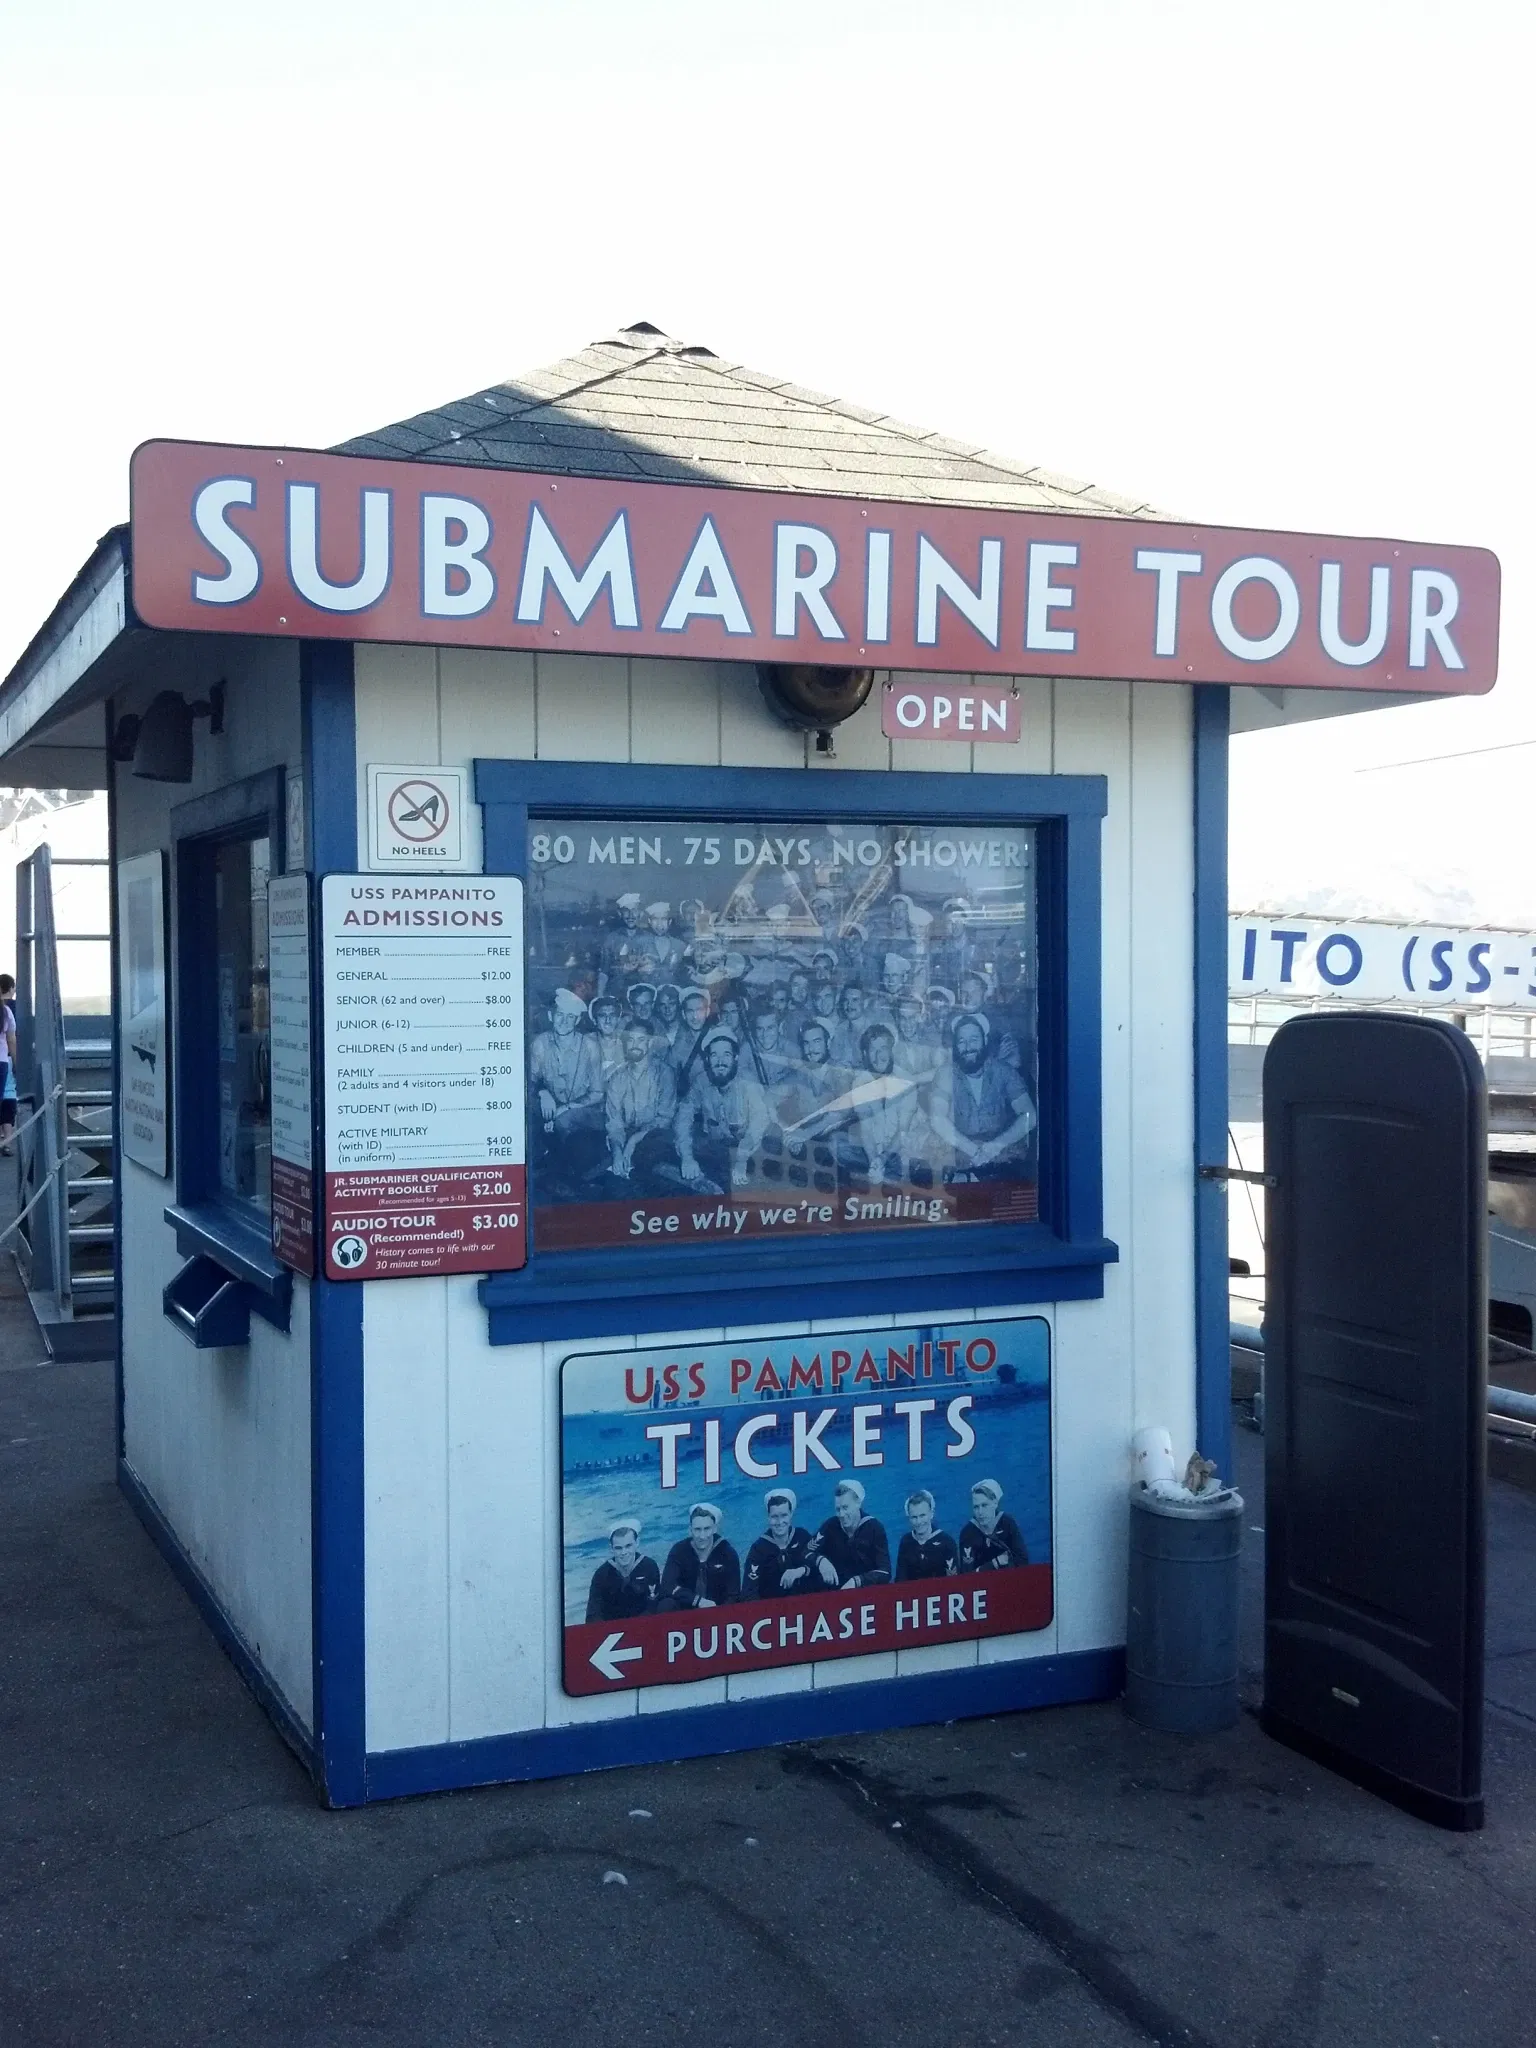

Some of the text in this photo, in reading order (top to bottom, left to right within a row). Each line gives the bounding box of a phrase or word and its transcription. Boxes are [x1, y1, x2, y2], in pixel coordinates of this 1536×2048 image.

[191, 475, 1468, 671] SUBMARINE TOUR
[896, 695, 1008, 731] OPEN
[392, 846, 447, 856] NO HEELS
[532, 835, 575, 863] 80
[588, 836, 672, 865] MEN.
[684, 837, 721, 865] 75
[734, 837, 821, 866] DAYS.
[832, 839, 882, 866] NO
[351, 888, 496, 901] USS PAMPANITO
[343, 910, 503, 926] ADMISSIONS
[336, 947, 510, 956] MEMBER FREE
[1242, 928, 1536, 997] ITO (SS-
[337, 971, 511, 980] GENERAL $12.00
[337, 995, 511, 1006] SENIOR (62 and over) $8.00
[336, 1019, 511, 1031] JUNIOR (6-12) $6.00
[337, 1042, 511, 1054] CHILDREN (5 and under) FREE
[337, 1066, 511, 1078] FAMILY $25.00
[338, 1078, 495, 1092] (2 adults and 4 visitors under 18)
[338, 1101, 512, 1115] STUDENT (with ID) $8.00
[338, 1127, 428, 1138] ACTIVE MILITARY
[338, 1136, 512, 1152] (with ID) $4.00
[338, 1148, 512, 1165] (in uniform) FREE
[334, 1171, 503, 1187] JR. SUBMARINER QUALIFICATION
[335, 1182, 511, 1197] ACTIVITY BOOKLET $2.00
[378, 1197, 425, 1206] (Recommended
[332, 1213, 518, 1231] AUDIO TOUR $3.00
[629, 1195, 950, 1235] See why we're Smiling.
[369, 1230, 464, 1245] (Recommended!)
[375, 1247, 405, 1257] History
[407, 1243, 434, 1253] comes
[436, 1244, 445, 1252] to
[447, 1242, 461, 1253] life
[462, 1241, 479, 1251] with
[375, 1258, 440, 1270] 30 minute tour!
[624, 1337, 998, 1404] USS PAMPANITO
[645, 1394, 977, 1489] TICKETS
[667, 1589, 989, 1663] PURCHASE HERE
